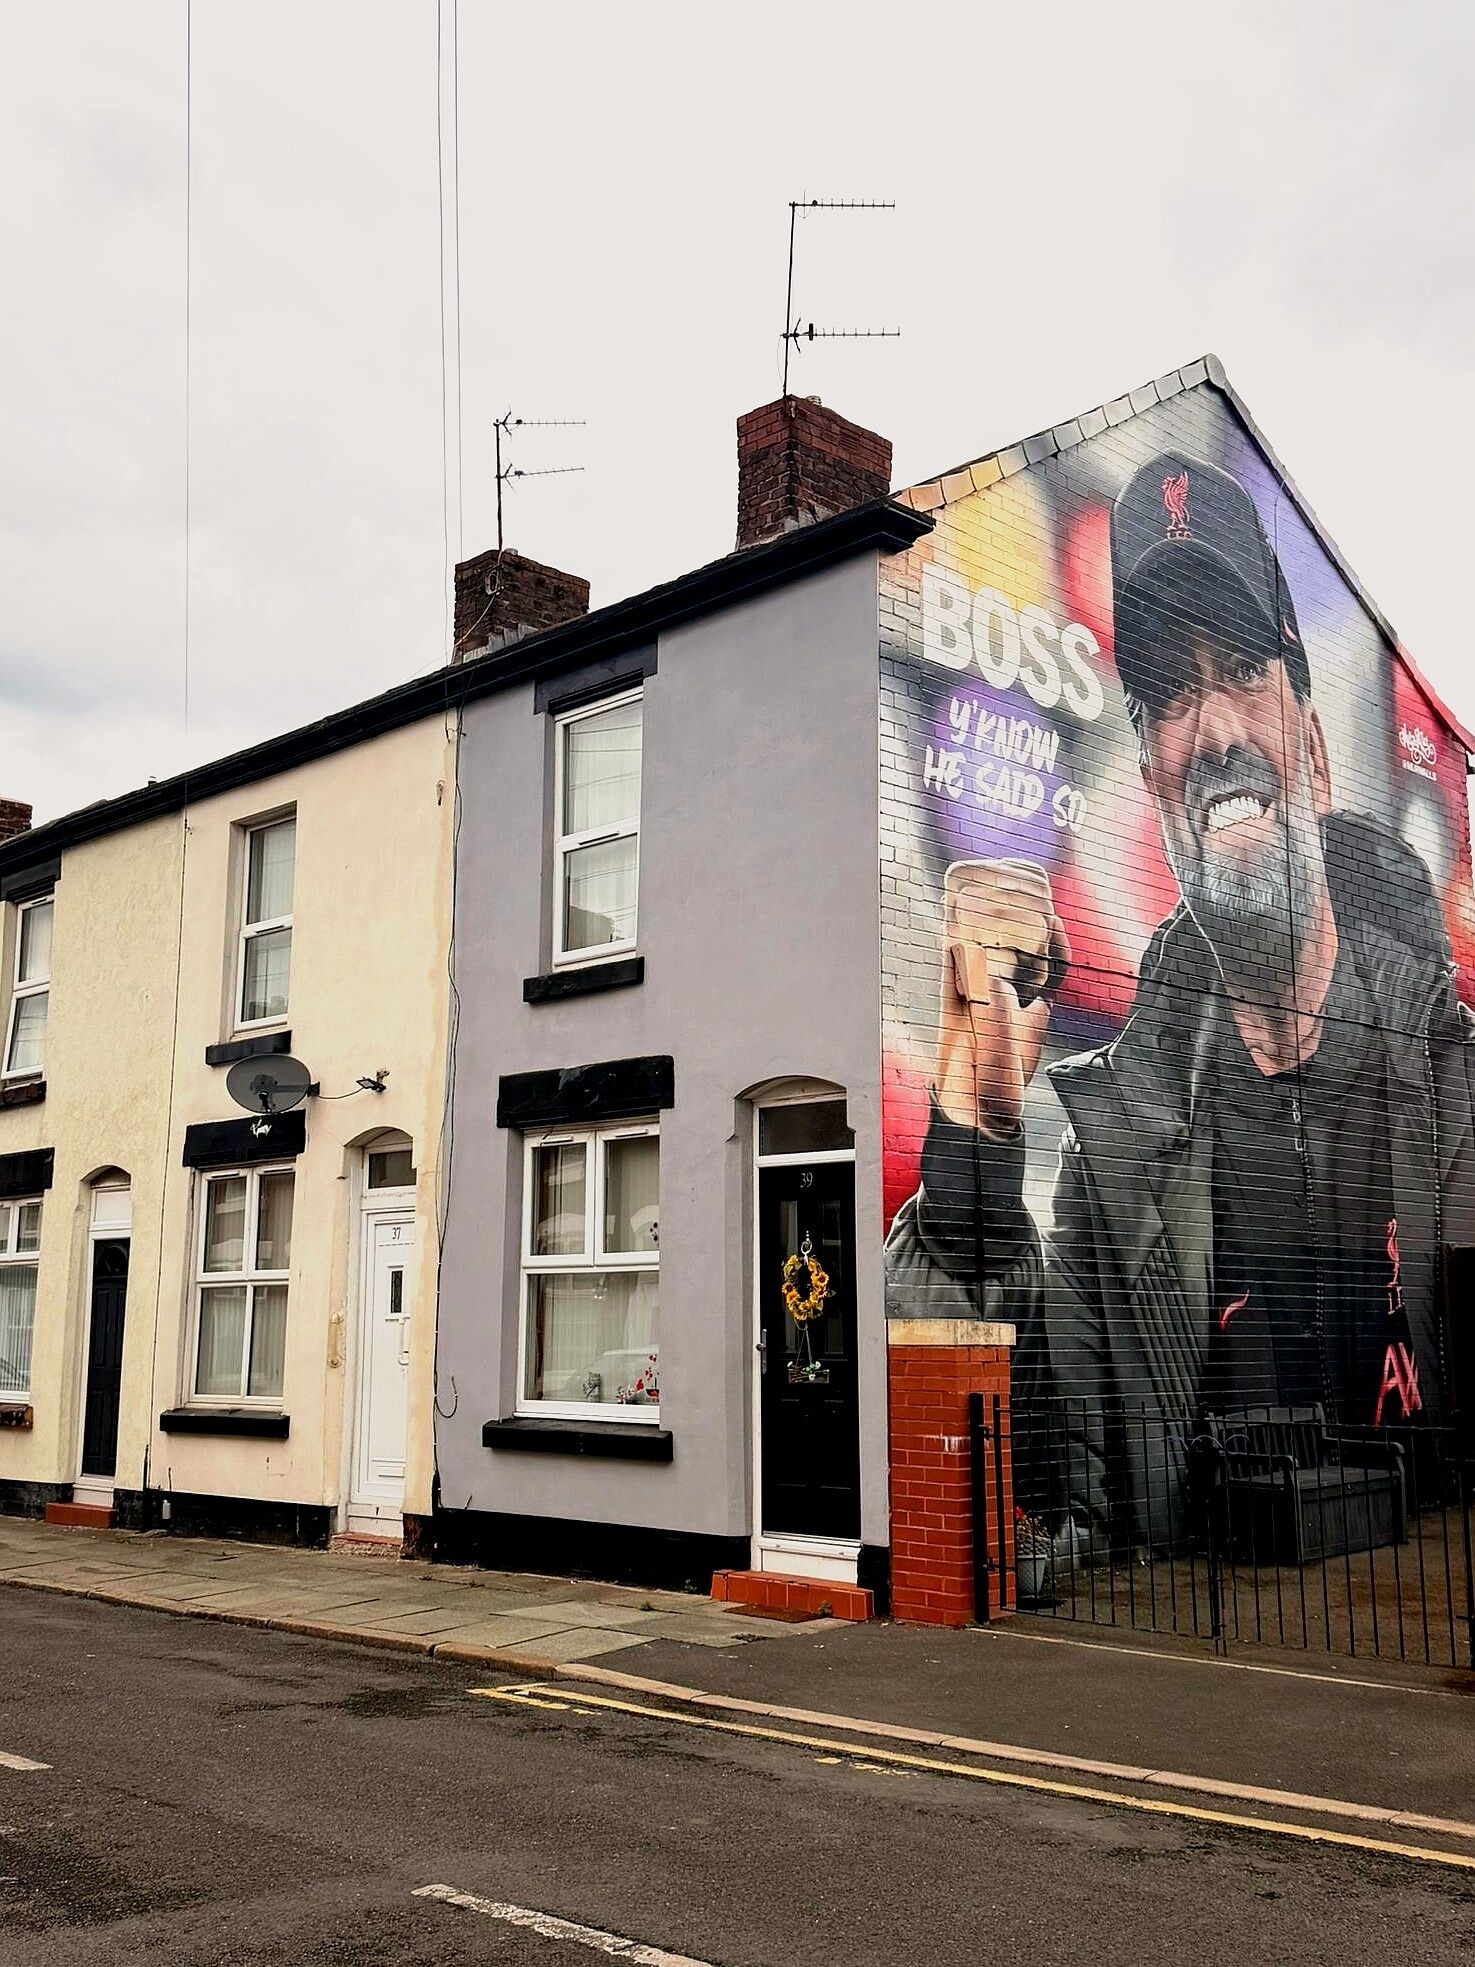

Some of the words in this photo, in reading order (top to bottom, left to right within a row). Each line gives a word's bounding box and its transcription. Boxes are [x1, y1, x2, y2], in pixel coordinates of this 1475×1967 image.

[921, 562, 1104, 722] BOSS
[949, 696, 1060, 774] Y'KNOW
[922, 743, 965, 801] HE
[974, 761, 1045, 820] SAID
[1052, 783, 1089, 834] SO
[800, 1171, 813, 1188] 39
[391, 1226, 402, 1240] 37
